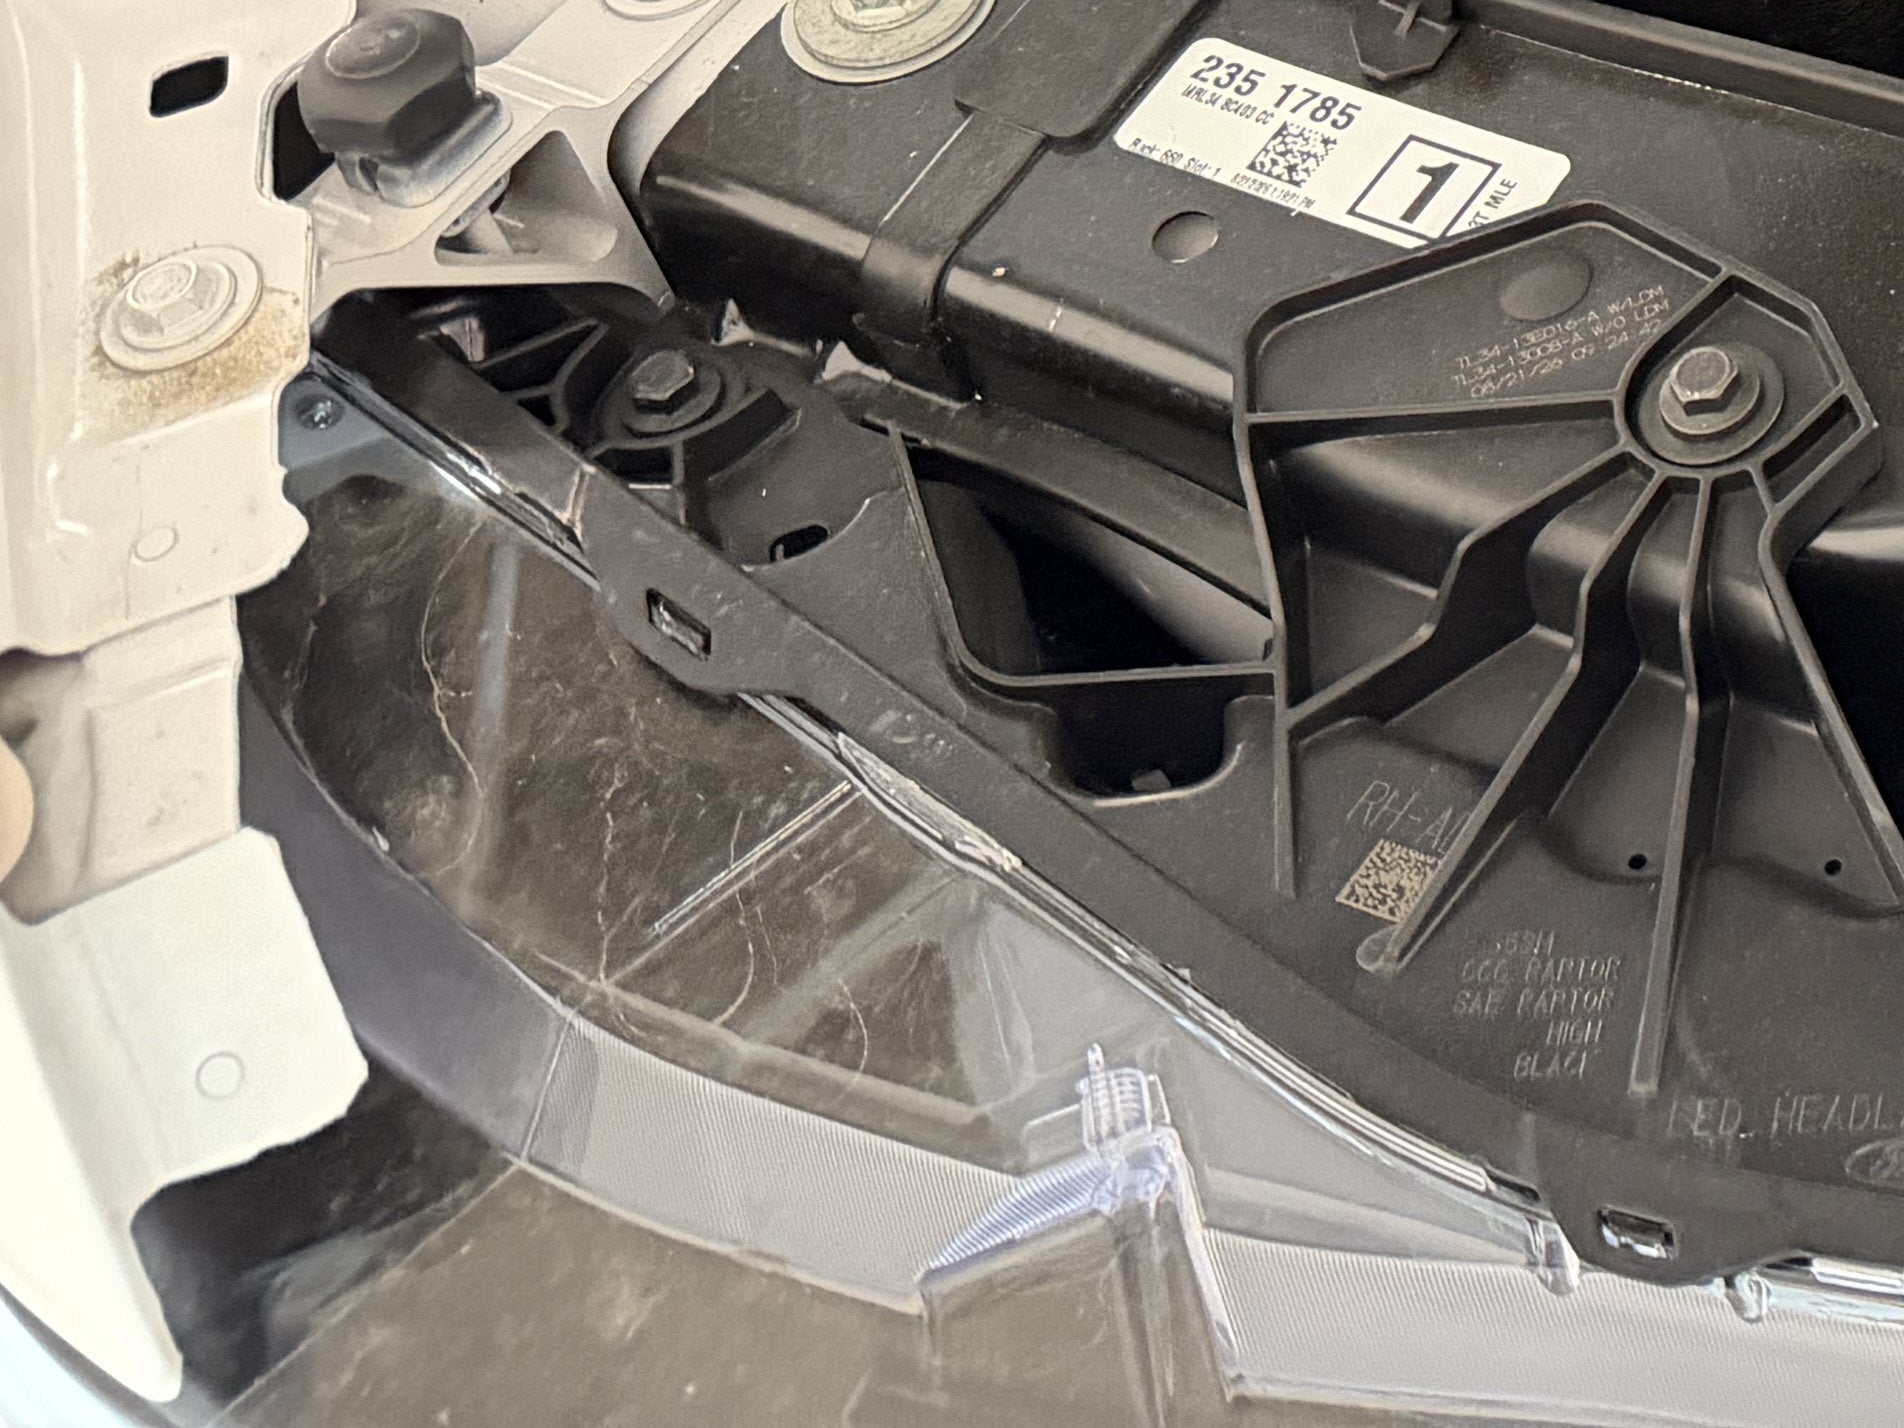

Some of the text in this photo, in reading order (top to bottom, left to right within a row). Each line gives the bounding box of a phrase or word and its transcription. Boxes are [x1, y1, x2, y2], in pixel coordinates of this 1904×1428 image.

[1186, 53, 1370, 131] 235 1785
[1398, 158, 1459, 224] 1
